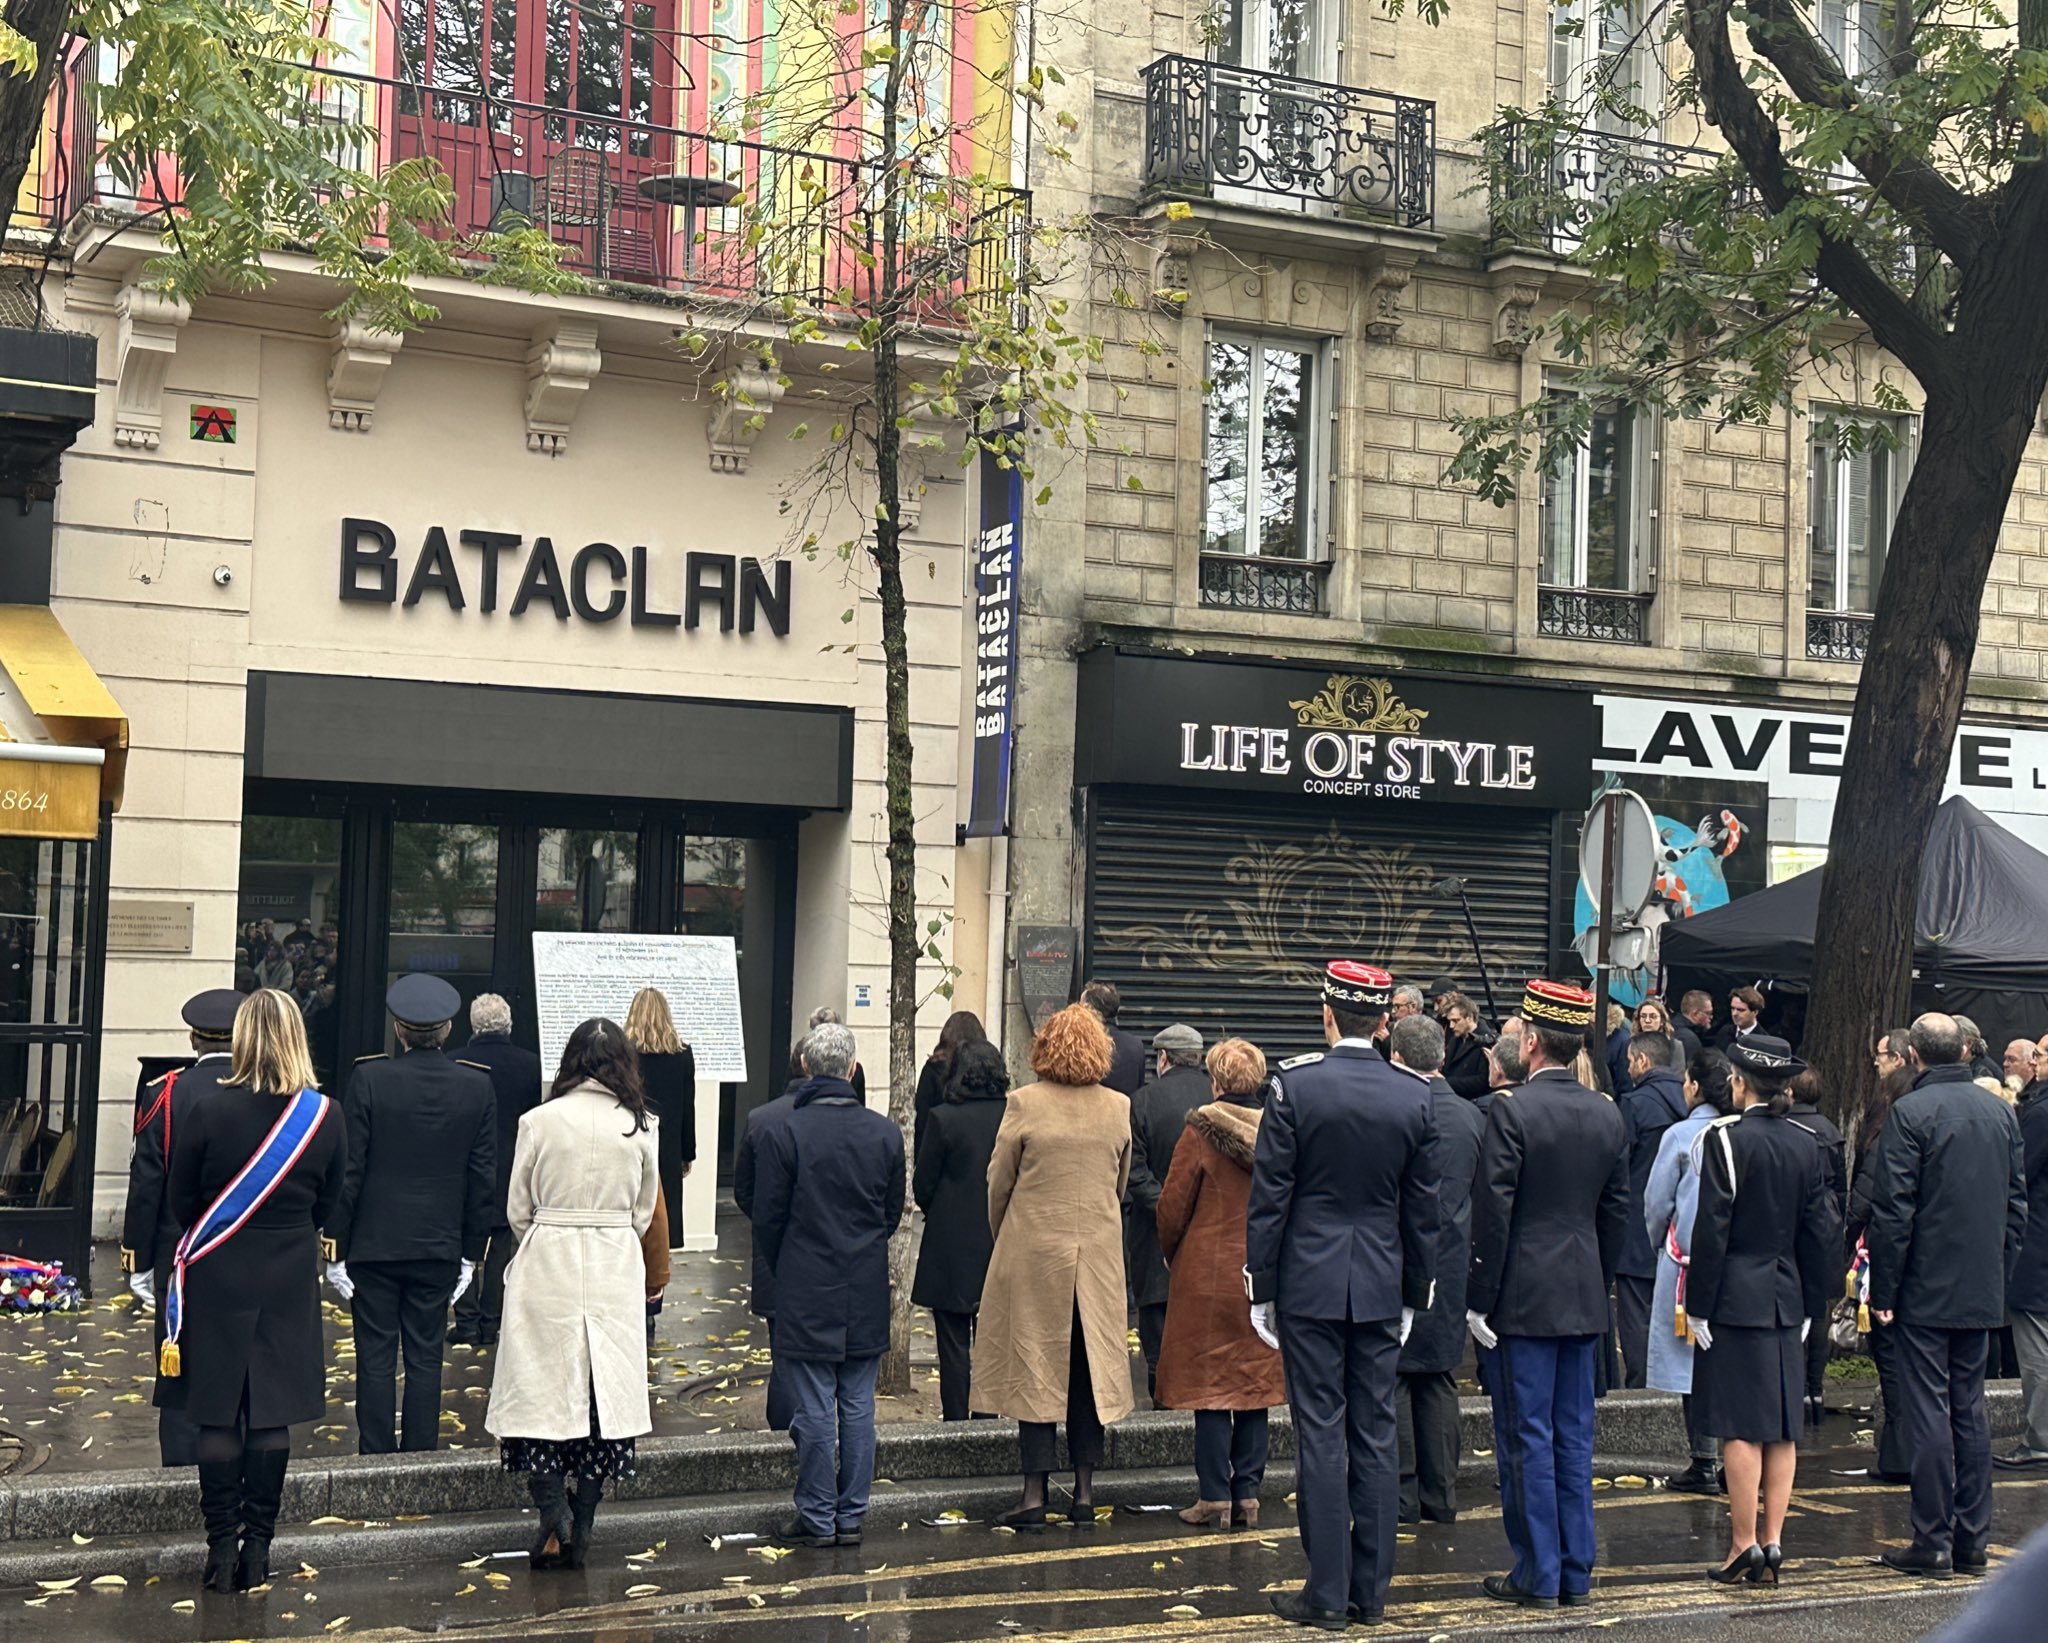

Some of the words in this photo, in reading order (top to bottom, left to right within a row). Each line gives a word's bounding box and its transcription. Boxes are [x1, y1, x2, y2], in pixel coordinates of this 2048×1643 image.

[340, 518, 792, 639] BATACLAN
[975, 522, 1014, 738] BATACLAN
[1180, 723, 1292, 775] LIFE
[1305, 731, 1377, 780] OF
[1386, 736, 1537, 791] STYLE
[1592, 702, 2013, 789] LAVEE
[0, 789, 49, 813] 864
[1303, 779, 1371, 796] CONCEPT
[1374, 783, 1421, 800] STORE
